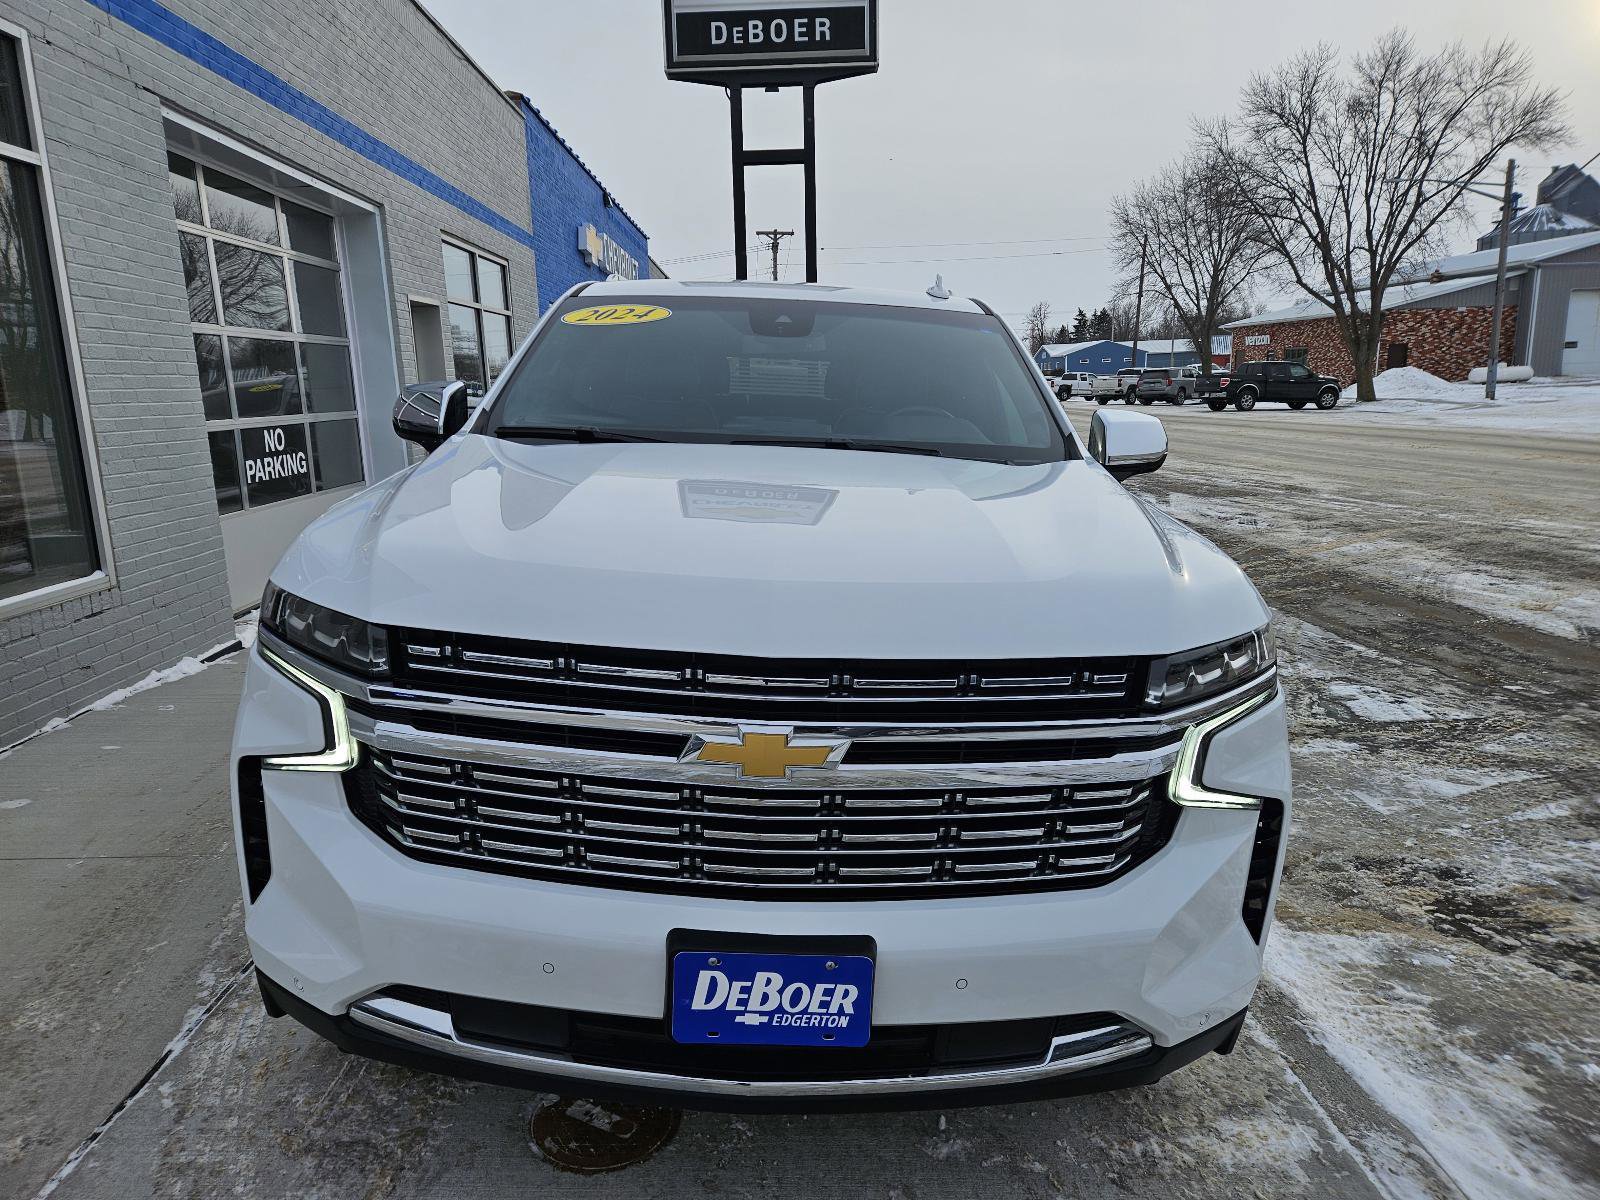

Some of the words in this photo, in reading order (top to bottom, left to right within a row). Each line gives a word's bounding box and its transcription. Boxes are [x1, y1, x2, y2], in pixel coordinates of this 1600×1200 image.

[574, 308, 656, 322] 2024
[263, 427, 285, 453] NO
[245, 451, 307, 484] PARKING
[772, 1013, 849, 1027] EDGERTON
